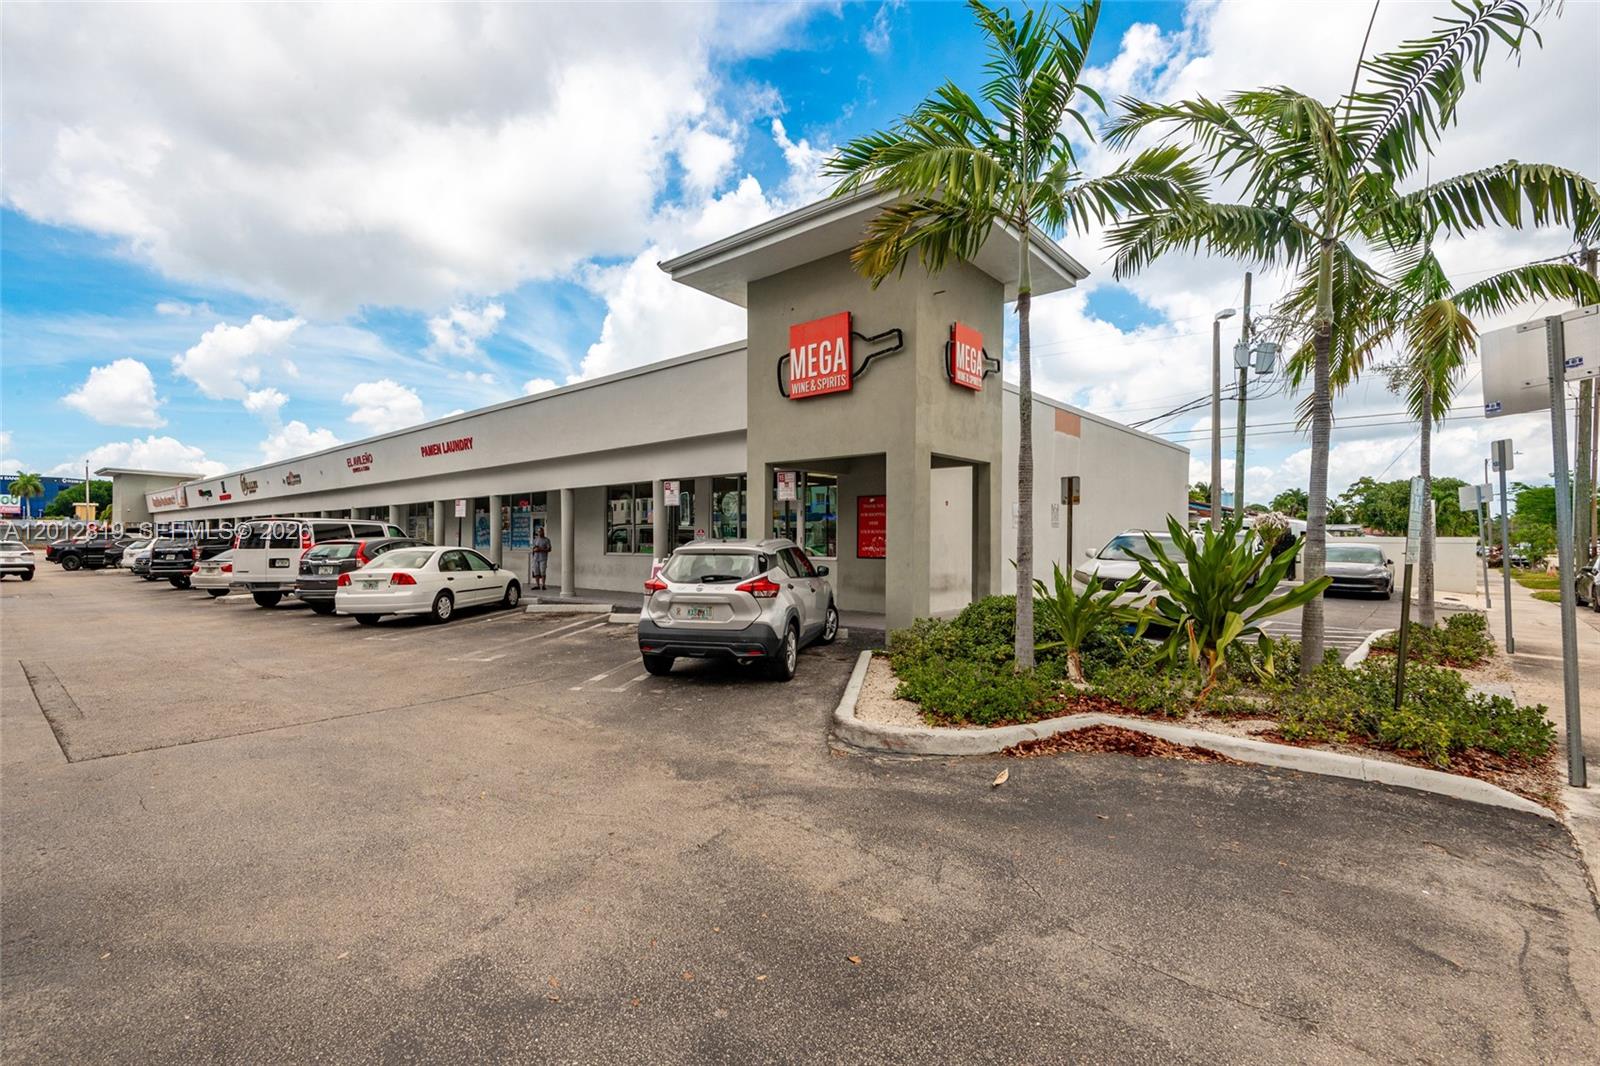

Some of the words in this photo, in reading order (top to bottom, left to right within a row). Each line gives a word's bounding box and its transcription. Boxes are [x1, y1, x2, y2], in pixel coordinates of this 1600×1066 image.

[790, 336, 847, 381] MEGA
[956, 341, 983, 377] MEGA
[791, 380, 809, 394] WINE
[817, 374, 846, 390] SPIRITS
[420, 443, 441, 457] PAMEN
[442, 437, 473, 454] LAUNDRY
